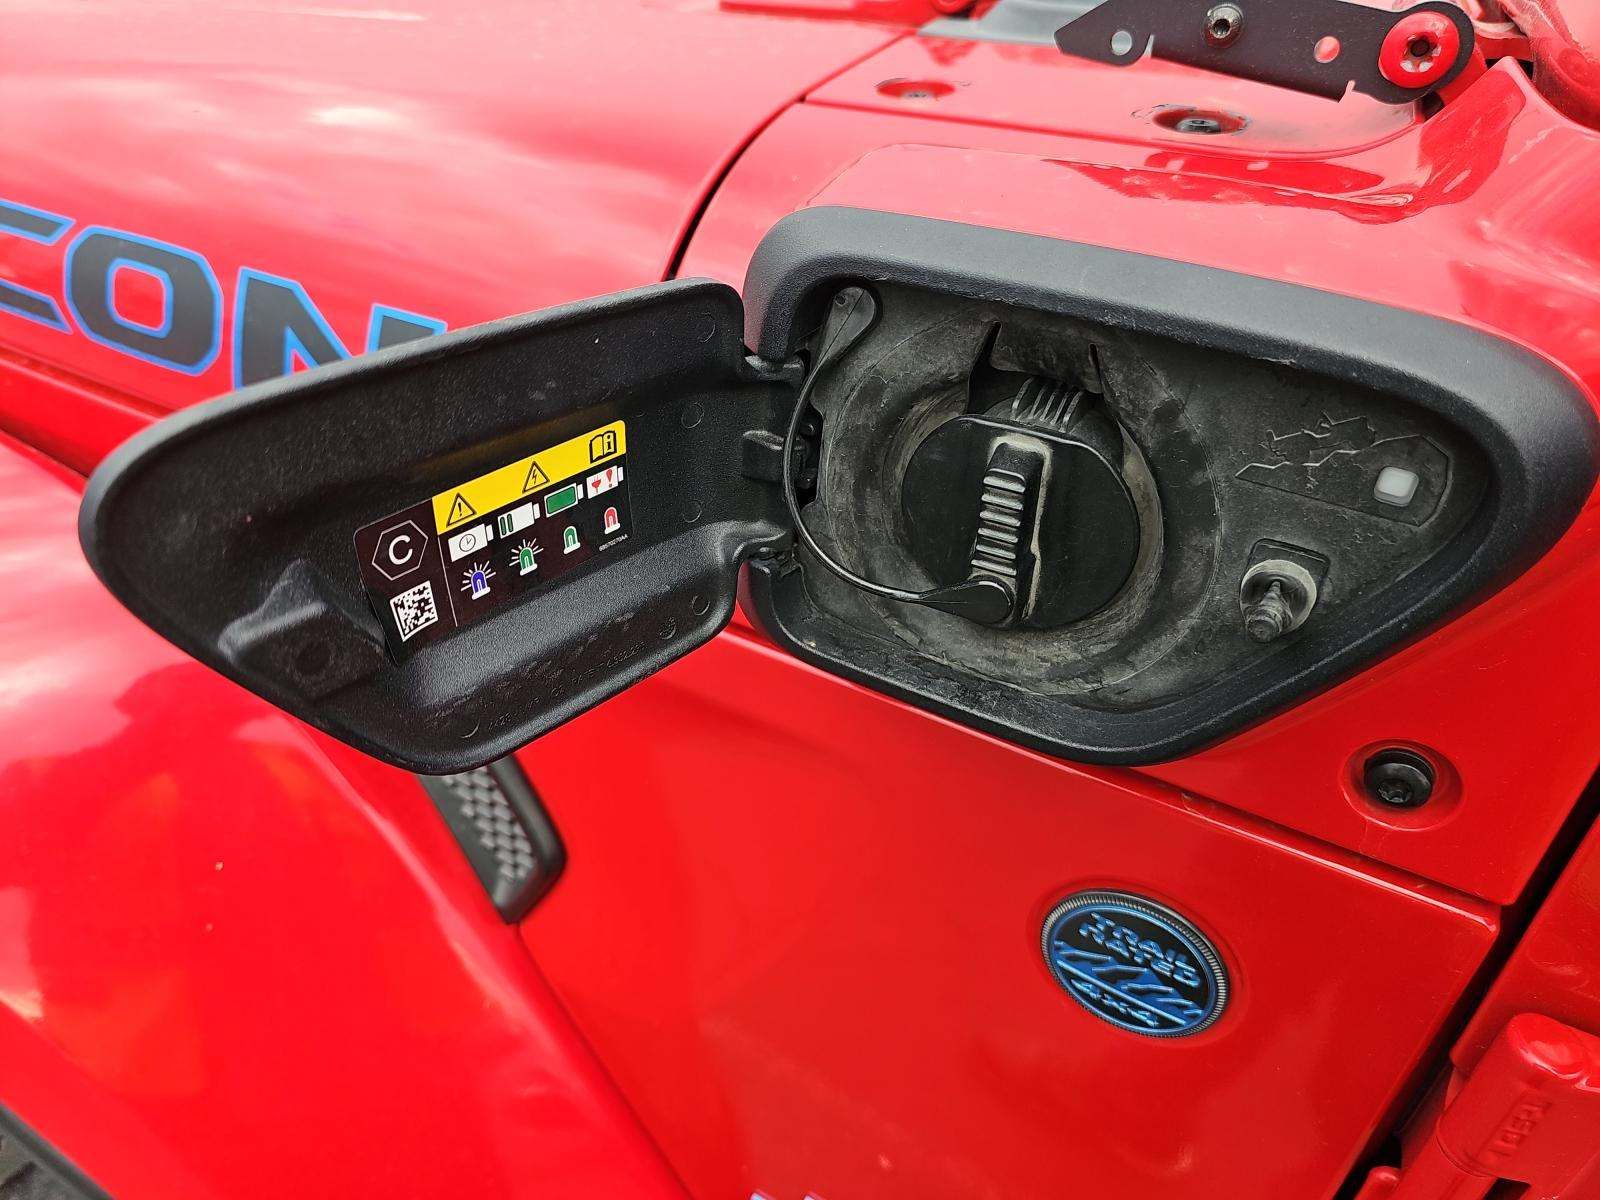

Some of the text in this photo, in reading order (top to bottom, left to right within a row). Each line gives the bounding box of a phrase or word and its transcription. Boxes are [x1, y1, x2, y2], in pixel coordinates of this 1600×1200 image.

[388, 534, 413, 565] C
[1079, 922, 1200, 987] RATED
[1090, 911, 1188, 963] TRAIL
